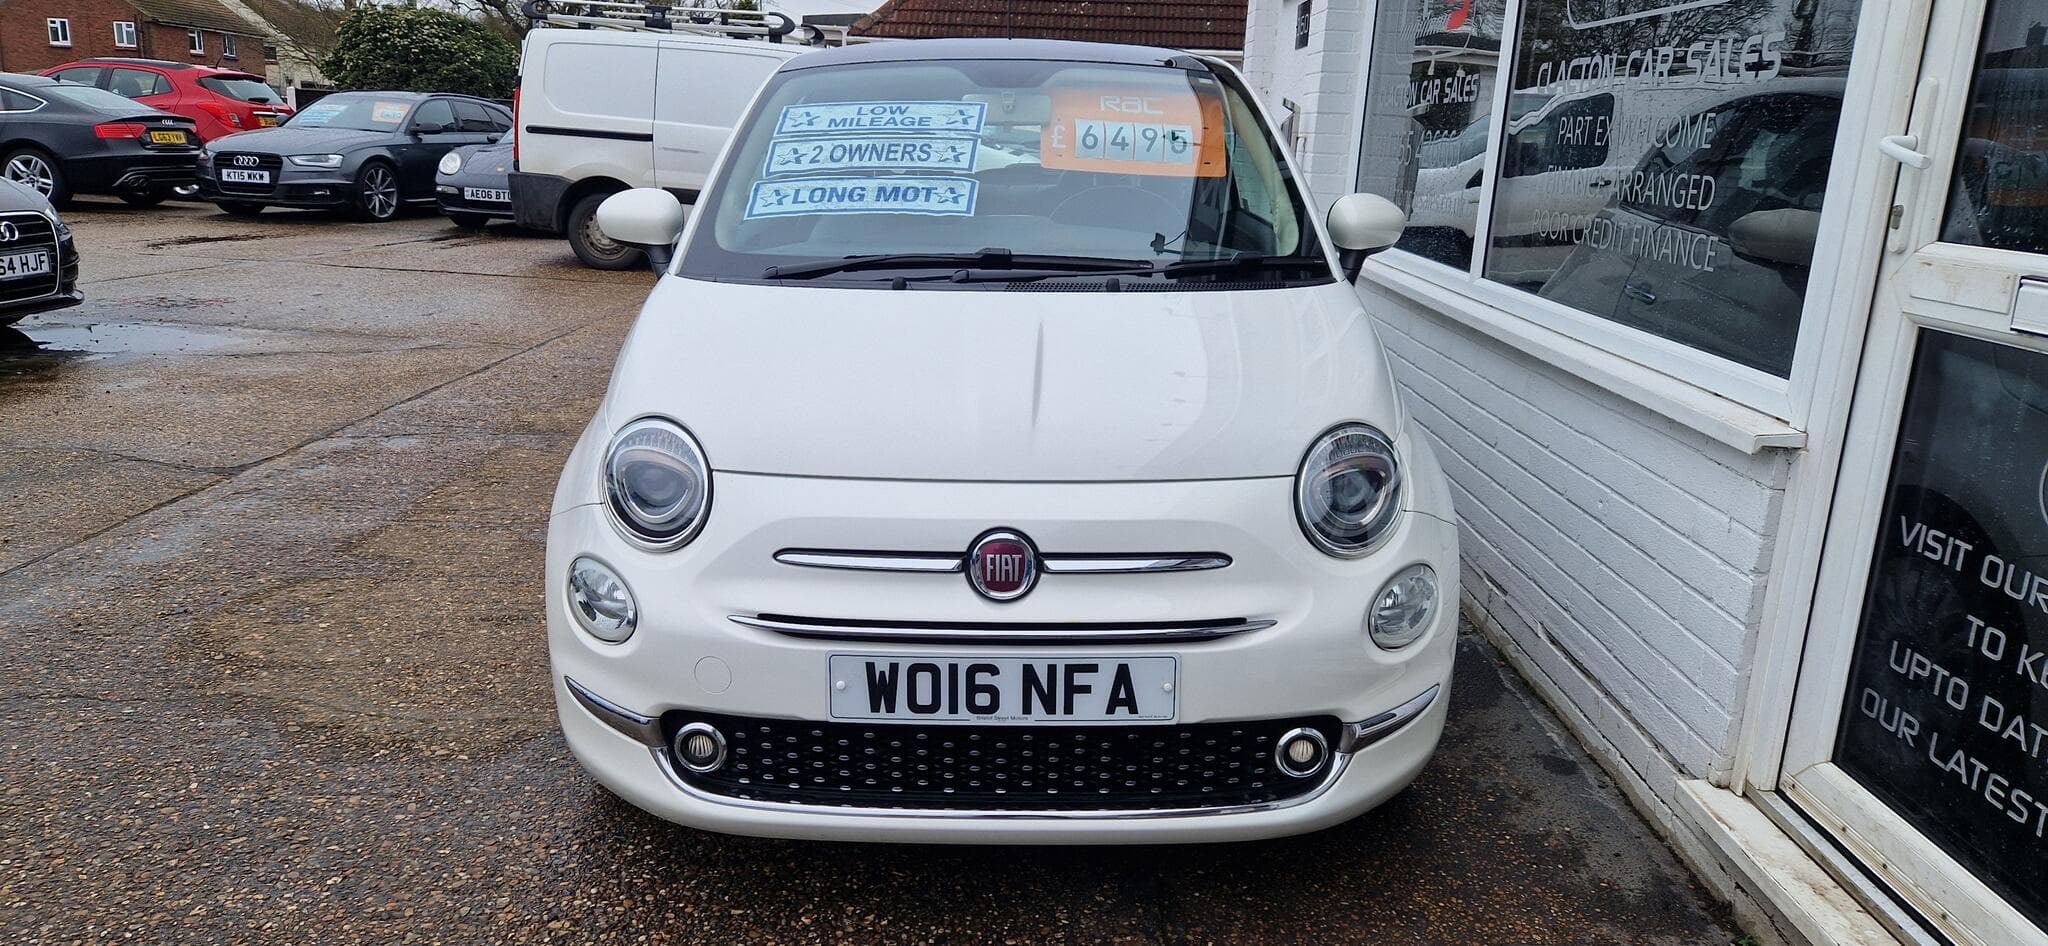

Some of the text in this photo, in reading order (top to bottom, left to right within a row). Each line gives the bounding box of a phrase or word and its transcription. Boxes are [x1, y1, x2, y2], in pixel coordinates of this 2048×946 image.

[1536, 31, 1786, 94] CLACTON CAR SALES
[1420, 79, 1441, 105] CAR
[1443, 73, 1480, 104] SALES
[827, 116, 933, 128] MILEAGE
[856, 105, 911, 116] LOW
[1051, 124, 1188, 154] £ 6495
[1557, 116, 1594, 146] PART
[1595, 115, 1615, 147] EX
[808, 143, 932, 164] 2 OWNERS
[226, 171, 246, 181] KT15
[1609, 170, 1716, 211] ARRANGED
[470, 189, 493, 200] AE06
[791, 186, 938, 205] LONG MOT
[1533, 208, 1719, 272] POOR CREDIT FINANCE
[19, 253, 46, 273] HJF
[986, 554, 1022, 582] FIAT
[1901, 515, 2048, 614] VISIT OUR
[1966, 614, 2007, 661] TO
[865, 662, 1139, 715] WO16 NFA
[1889, 640, 1969, 710] UPTO
[1861, 687, 2048, 837] OUR LATEST
